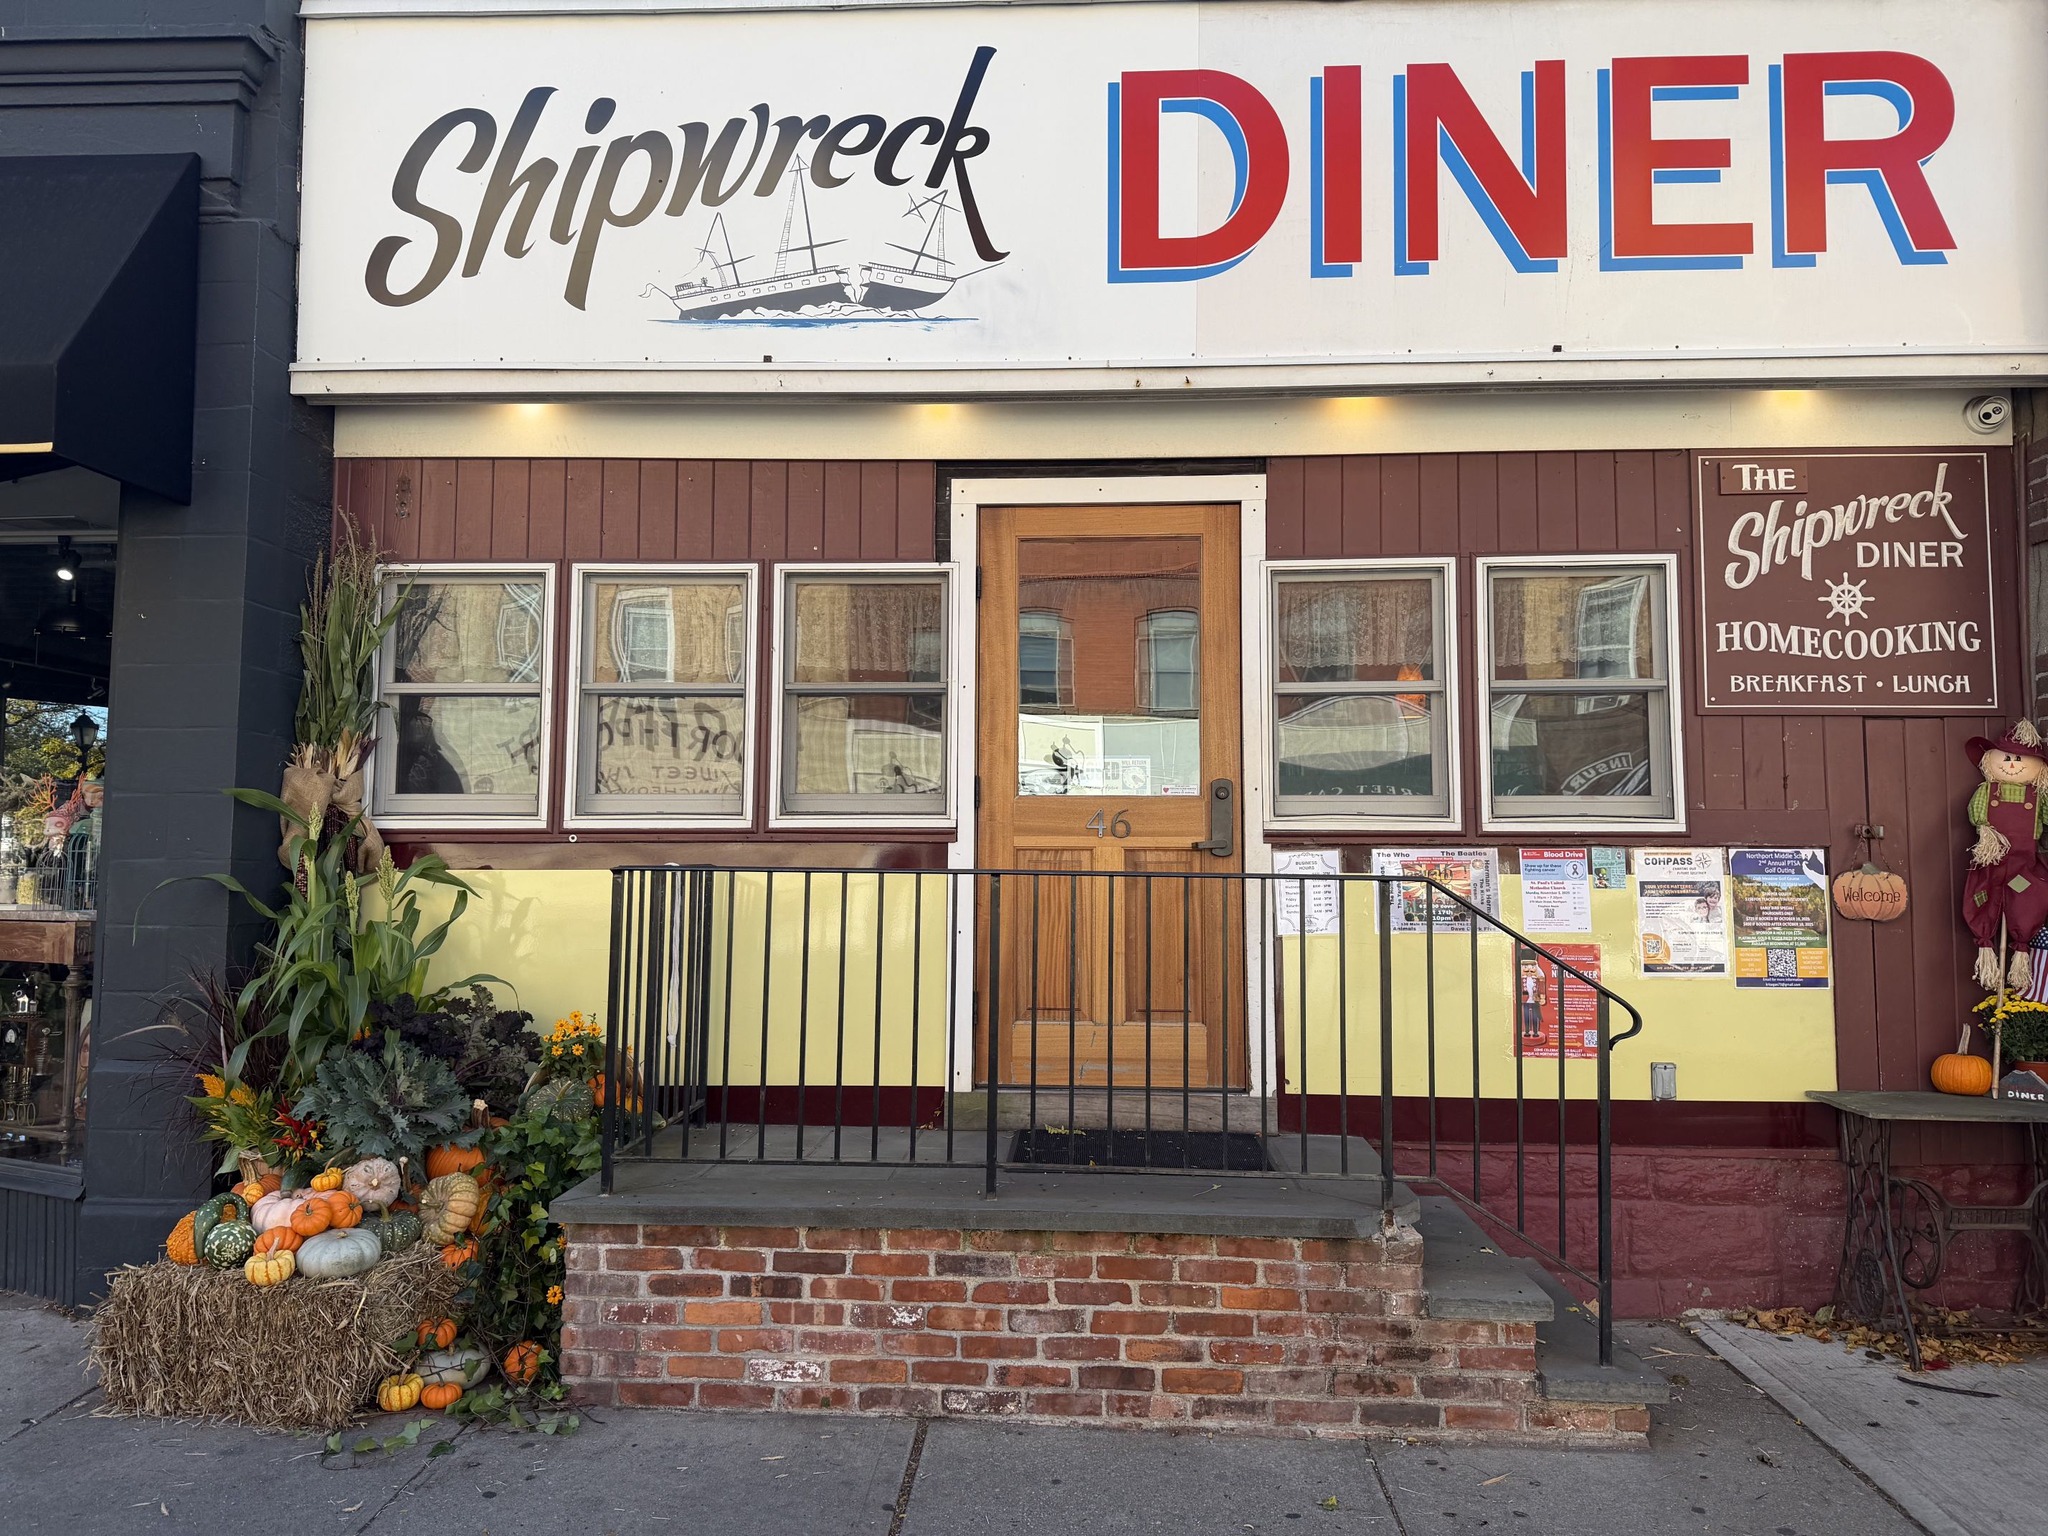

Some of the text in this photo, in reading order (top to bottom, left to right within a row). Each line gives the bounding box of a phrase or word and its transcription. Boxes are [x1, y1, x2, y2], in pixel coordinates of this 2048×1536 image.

[364, 45, 1957, 311] Shipwreck DINER
[1732, 464, 1797, 491] THE
[1724, 462, 1969, 590] Shipwreck
[1856, 541, 1965, 568] DINER
[1715, 620, 1982, 660] HOMECOOKING
[1730, 674, 1971, 694] BREAKFAST LUNCH
[1086, 808, 1132, 838] 46
[1842, 885, 1901, 904] Welcome
[2007, 1090, 2046, 1101] DINER
